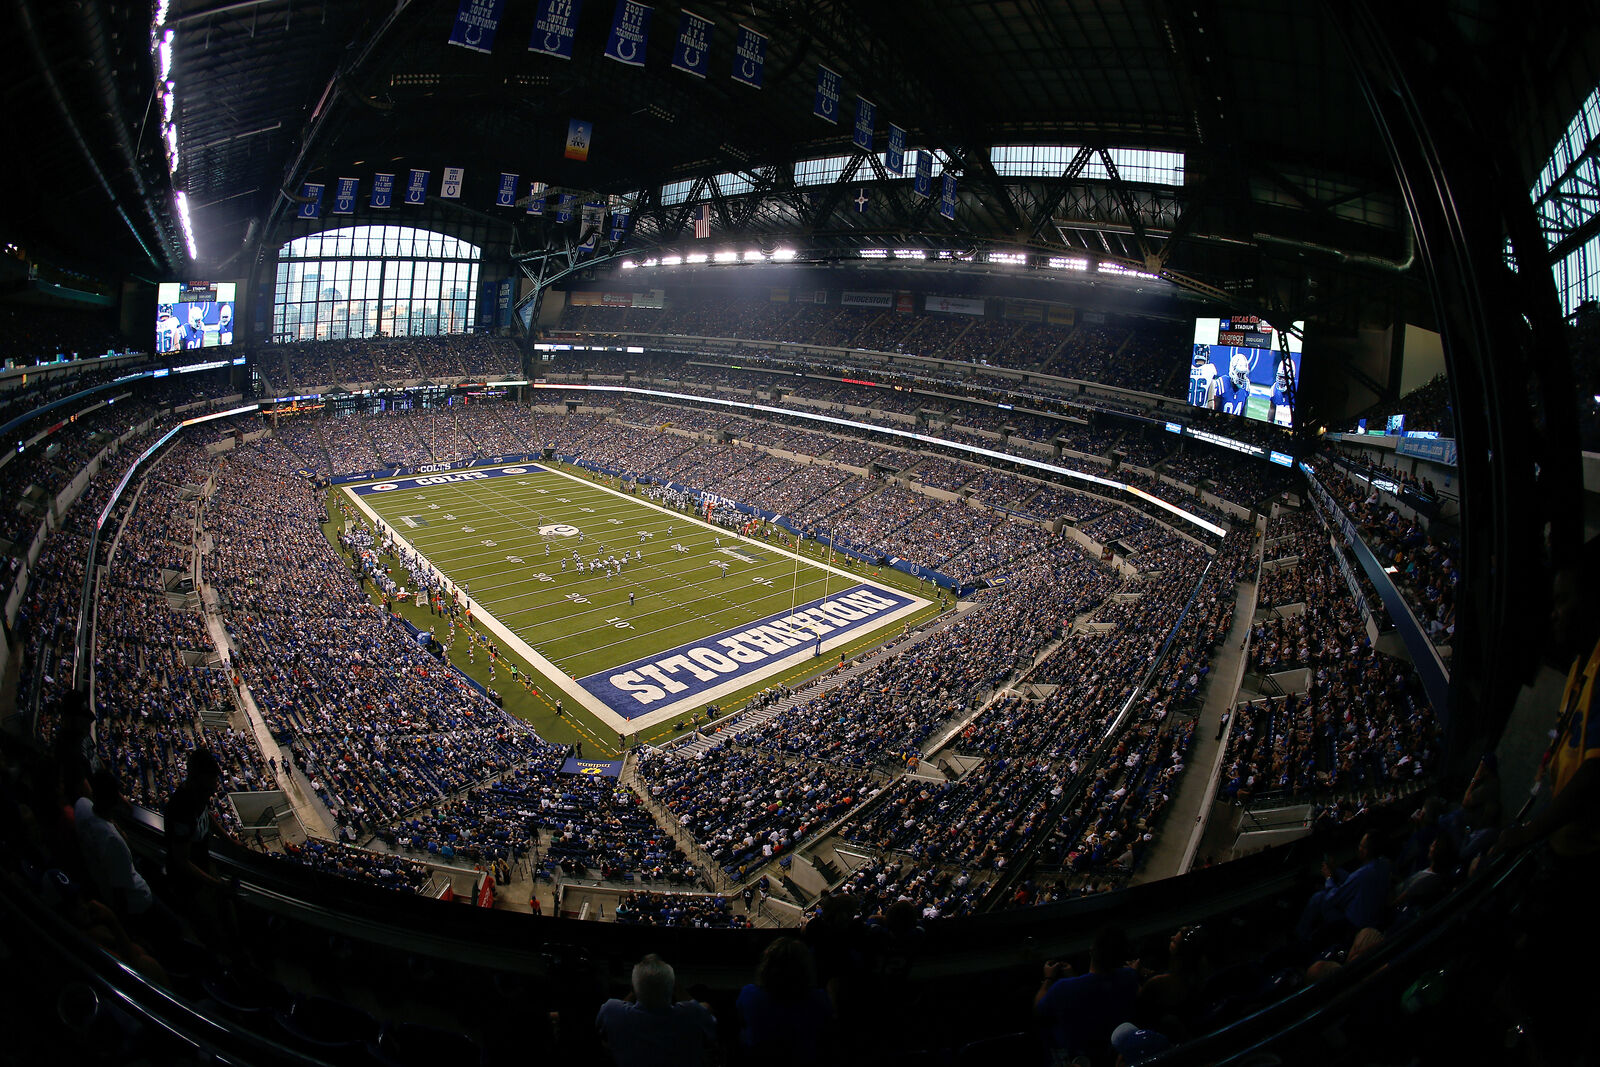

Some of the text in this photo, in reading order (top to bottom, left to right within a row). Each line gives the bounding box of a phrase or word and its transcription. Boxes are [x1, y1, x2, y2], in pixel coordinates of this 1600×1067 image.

[469, 4, 493, 19] SOUTH
[459, 11, 498, 31] CHAMPIONS
[547, 13, 569, 27] SOUTH
[536, 20, 575, 38] CHAMPIONS
[679, 33, 708, 53] FINALIST
[843, 294, 890, 305] BRIDGESTONE
[1231, 315, 1249, 323] LUCAS
[420, 462, 451, 473] COLTS
[415, 471, 489, 486] COLTS
[700, 491, 736, 510] COLTS
[533, 572, 553, 582] 30
[752, 576, 774, 588] 10
[565, 592, 588, 604] 20
[605, 616, 630, 629] 10
[609, 589, 898, 705] INDIANAPOLIS
